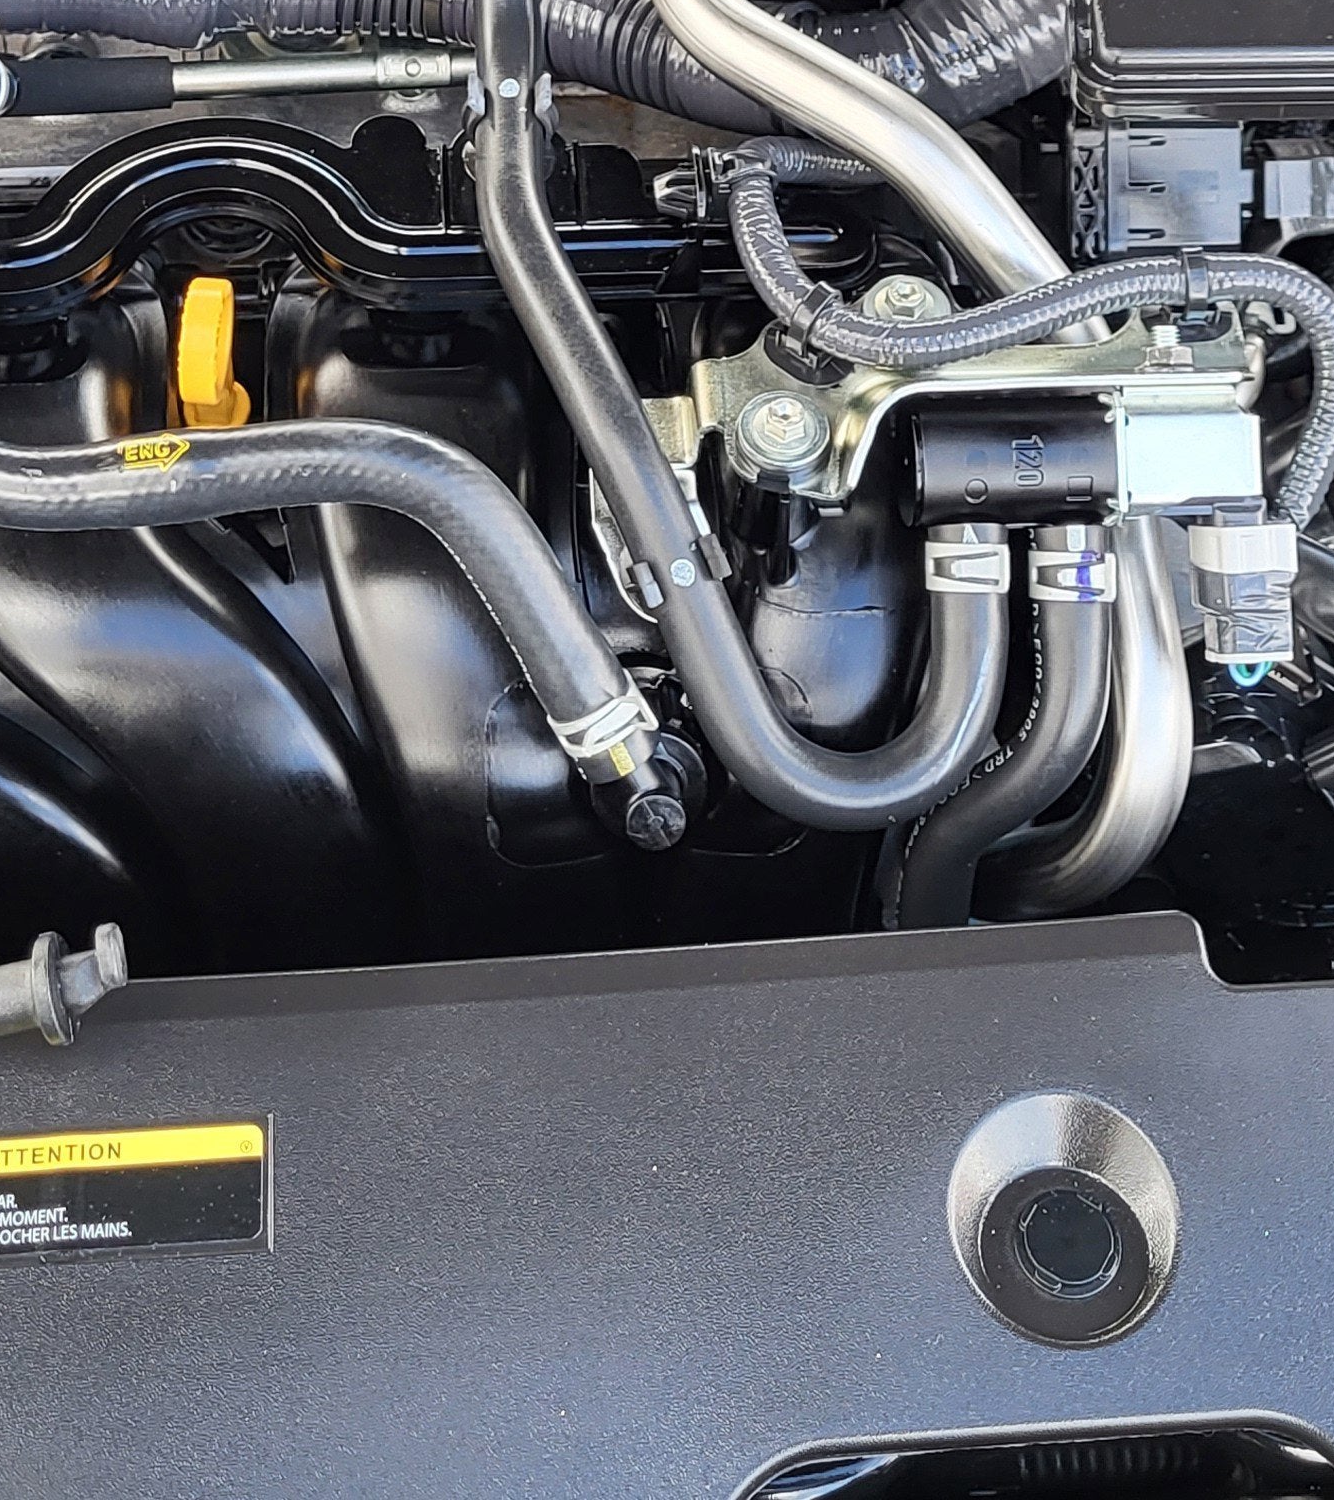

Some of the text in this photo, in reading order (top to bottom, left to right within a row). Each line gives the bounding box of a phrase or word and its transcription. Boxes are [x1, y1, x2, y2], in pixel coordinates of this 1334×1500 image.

[125, 441, 170, 462] ENG
[1011, 434, 1045, 488] 120
[0, 1207, 69, 1227] MOMENT.
[53, 1225, 78, 1241] LES
[81, 1221, 132, 1239] MAINS.
